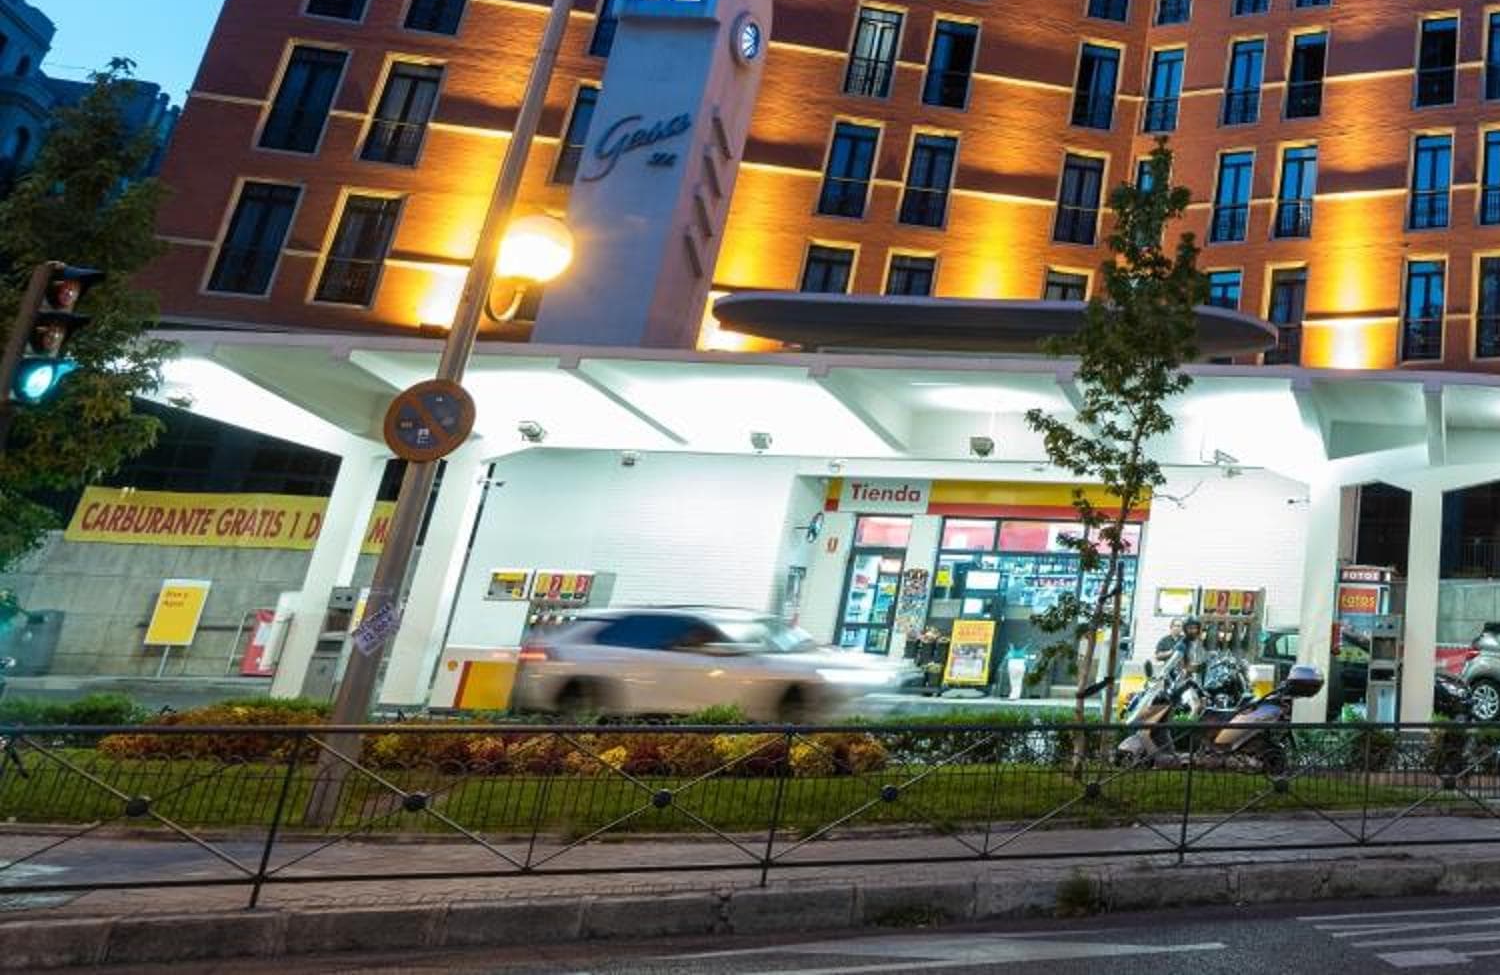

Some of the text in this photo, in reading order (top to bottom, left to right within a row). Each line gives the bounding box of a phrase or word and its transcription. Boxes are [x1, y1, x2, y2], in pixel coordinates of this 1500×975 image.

[851, 483, 922, 503] Tienda
[80, 501, 216, 536] CARBURANTE
[216, 507, 286, 539] GRATIS
[1342, 570, 1379, 582] FOTOS
